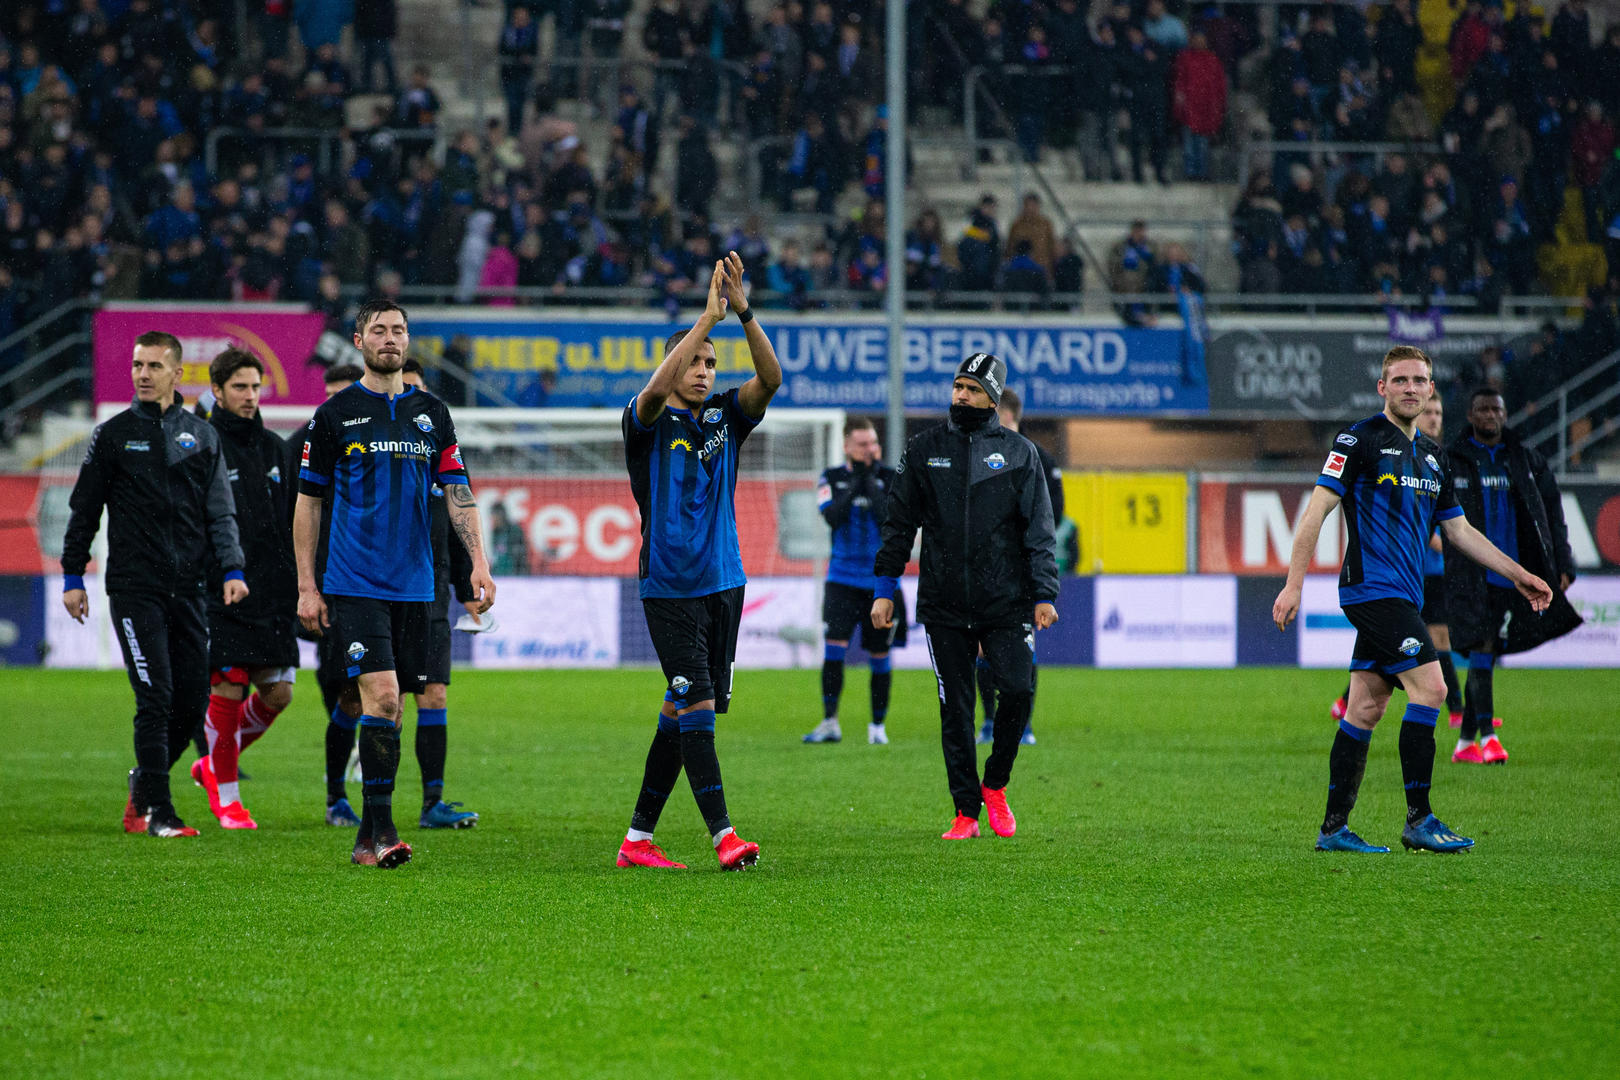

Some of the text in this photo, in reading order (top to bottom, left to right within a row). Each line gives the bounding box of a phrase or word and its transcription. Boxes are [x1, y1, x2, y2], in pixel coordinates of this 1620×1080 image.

[776, 329, 887, 372] UWE
[904, 329, 1127, 374] BERNARD
[1400, 475, 1441, 493] sunmak
[1125, 494, 1163, 527] 13
